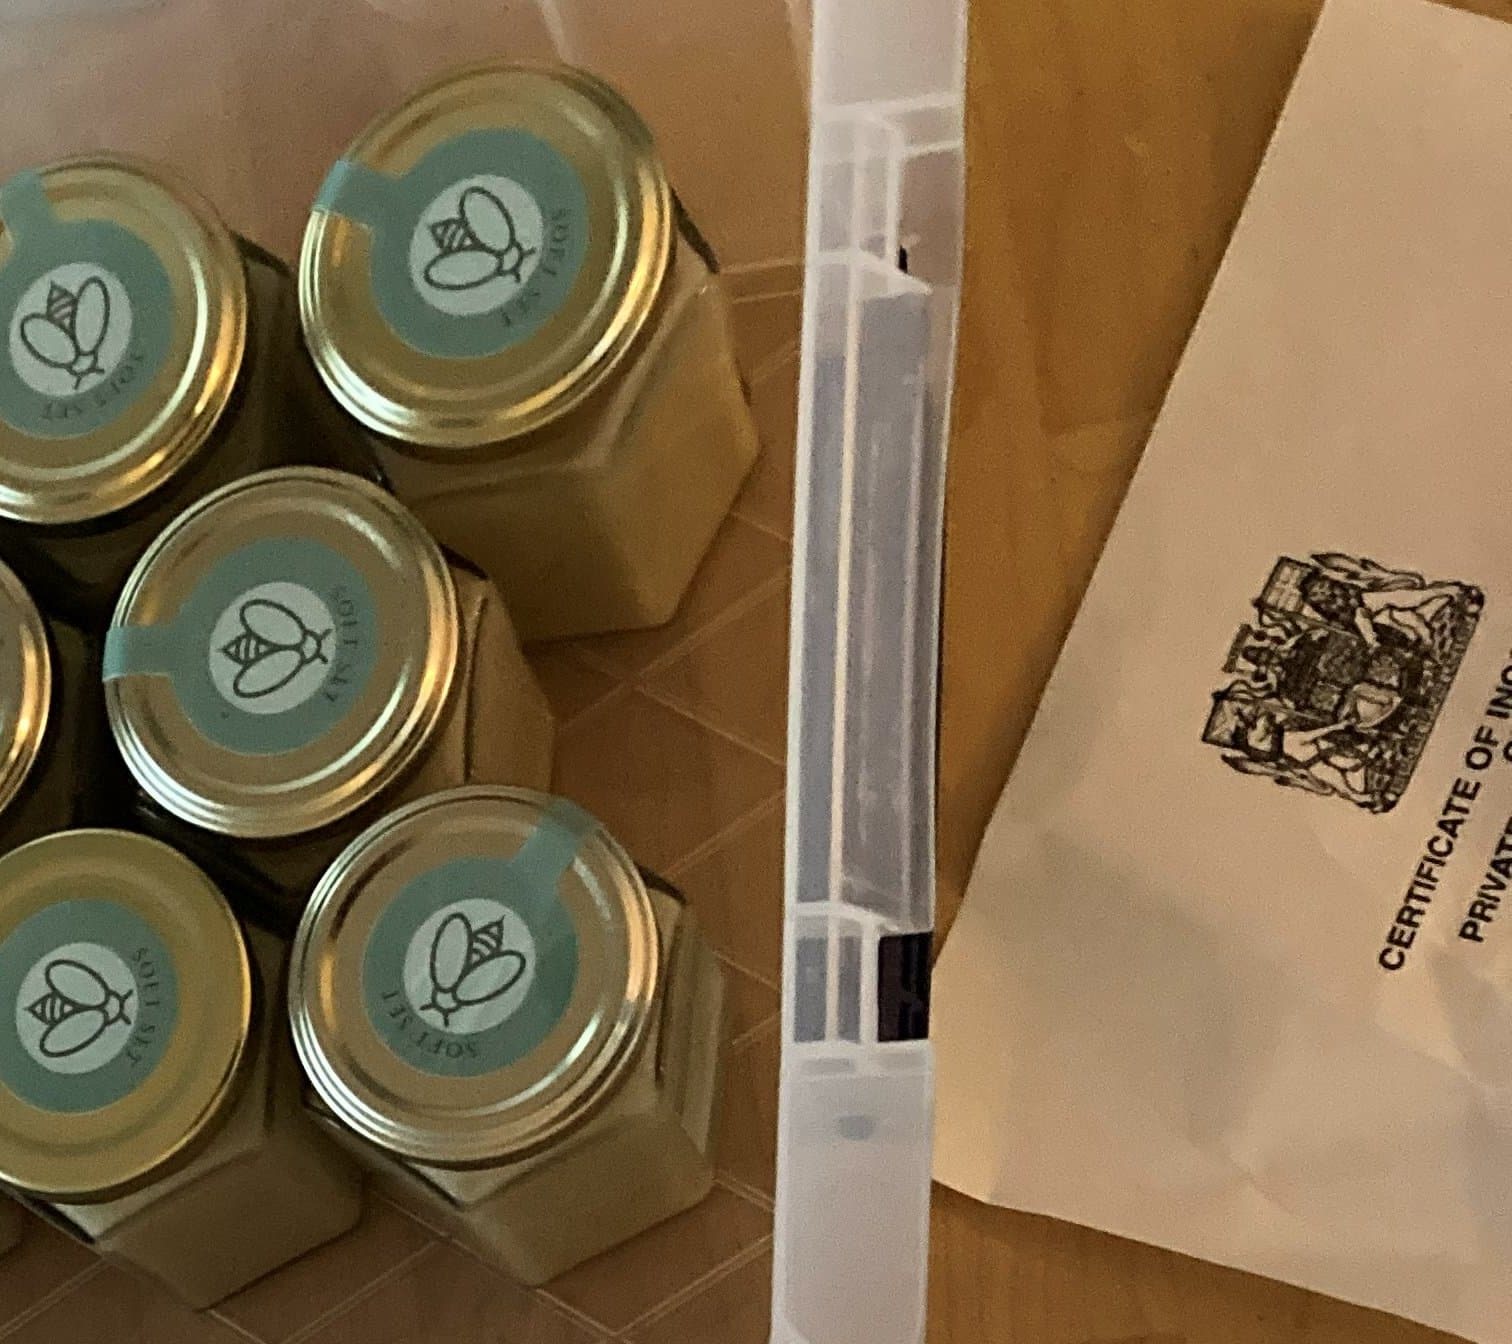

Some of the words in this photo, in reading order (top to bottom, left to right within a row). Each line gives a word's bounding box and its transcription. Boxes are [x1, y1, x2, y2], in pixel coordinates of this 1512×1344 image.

[1379, 777, 1481, 971] CERTIFICATE
[1465, 725, 1499, 771] OF
[1458, 815, 1512, 942] PRIVAT
[136, 946, 162, 1007] SOFT
[381, 991, 409, 1031] SET
[127, 1020, 161, 1062] SET
[415, 1029, 480, 1059] SOFT
